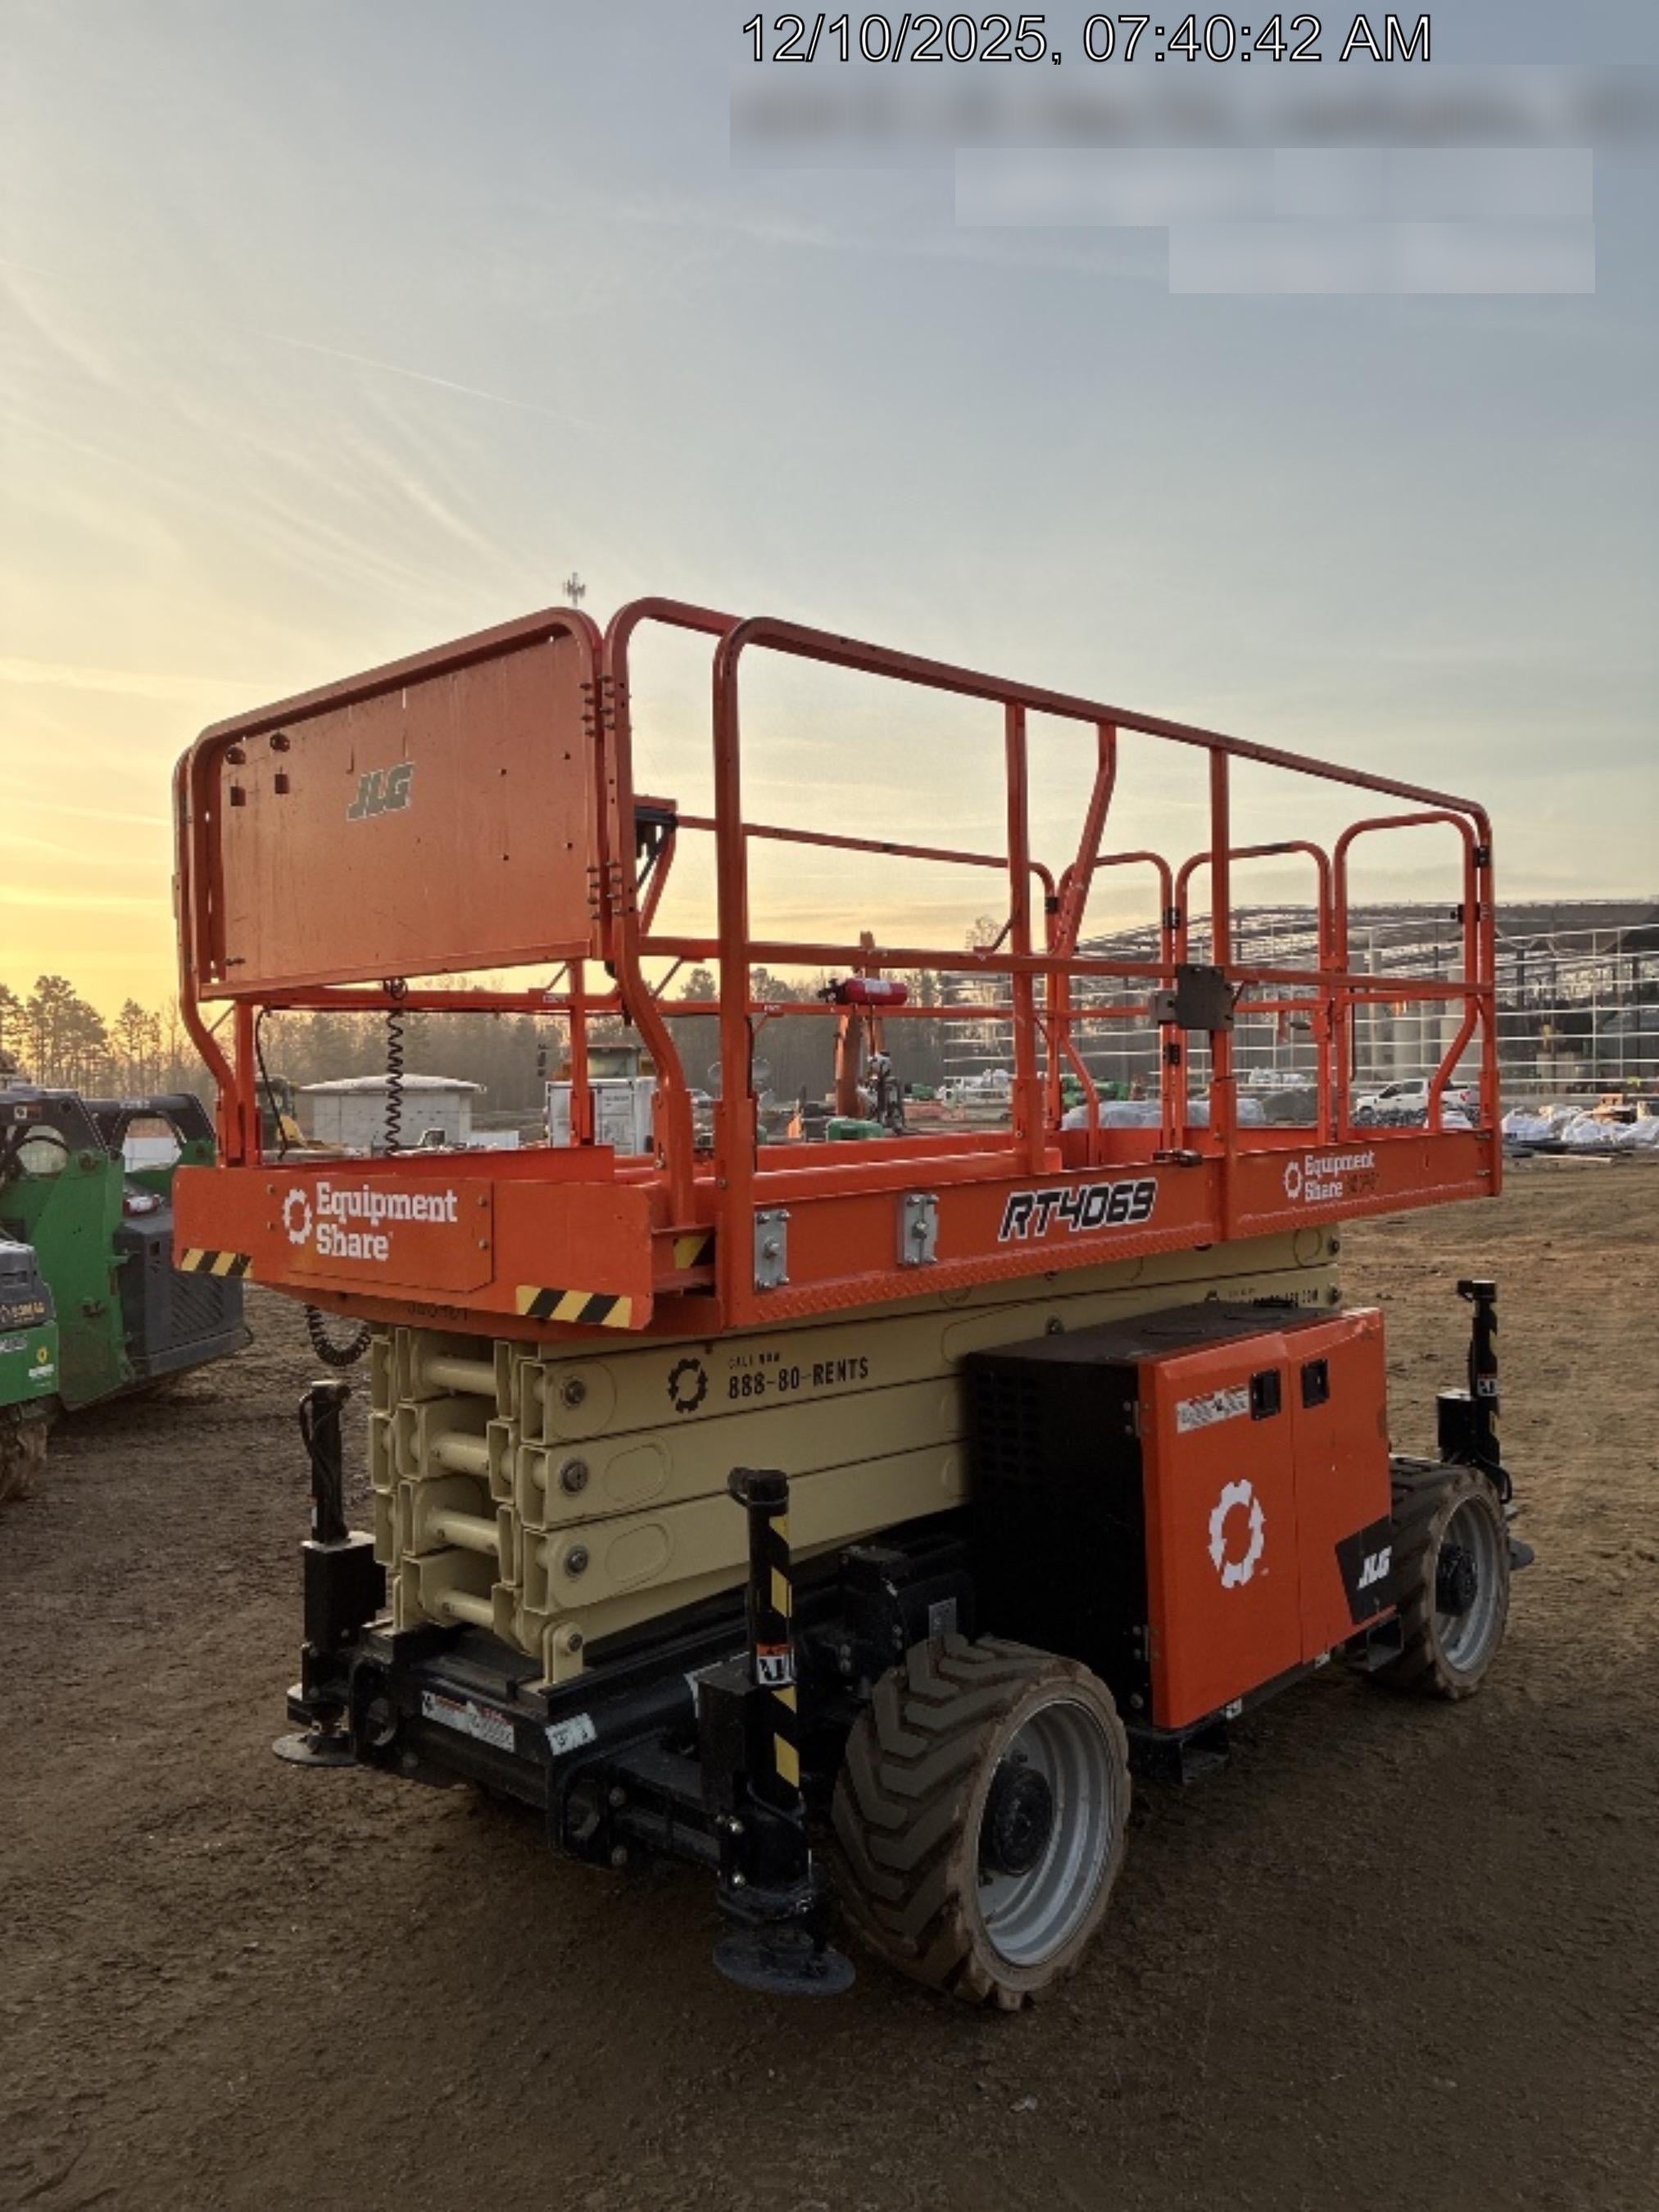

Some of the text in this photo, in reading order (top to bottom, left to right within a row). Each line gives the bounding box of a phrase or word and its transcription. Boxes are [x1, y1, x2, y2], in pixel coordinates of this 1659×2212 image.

[347, 761, 415, 821] JLG
[1304, 1149, 1376, 1178] Equipment
[316, 1181, 458, 1227] Equipment
[998, 1176, 1158, 1242] RT4069
[1304, 1180, 1344, 1202] Share
[316, 1223, 389, 1262] Share
[1357, 1545, 1393, 1591] JLG
